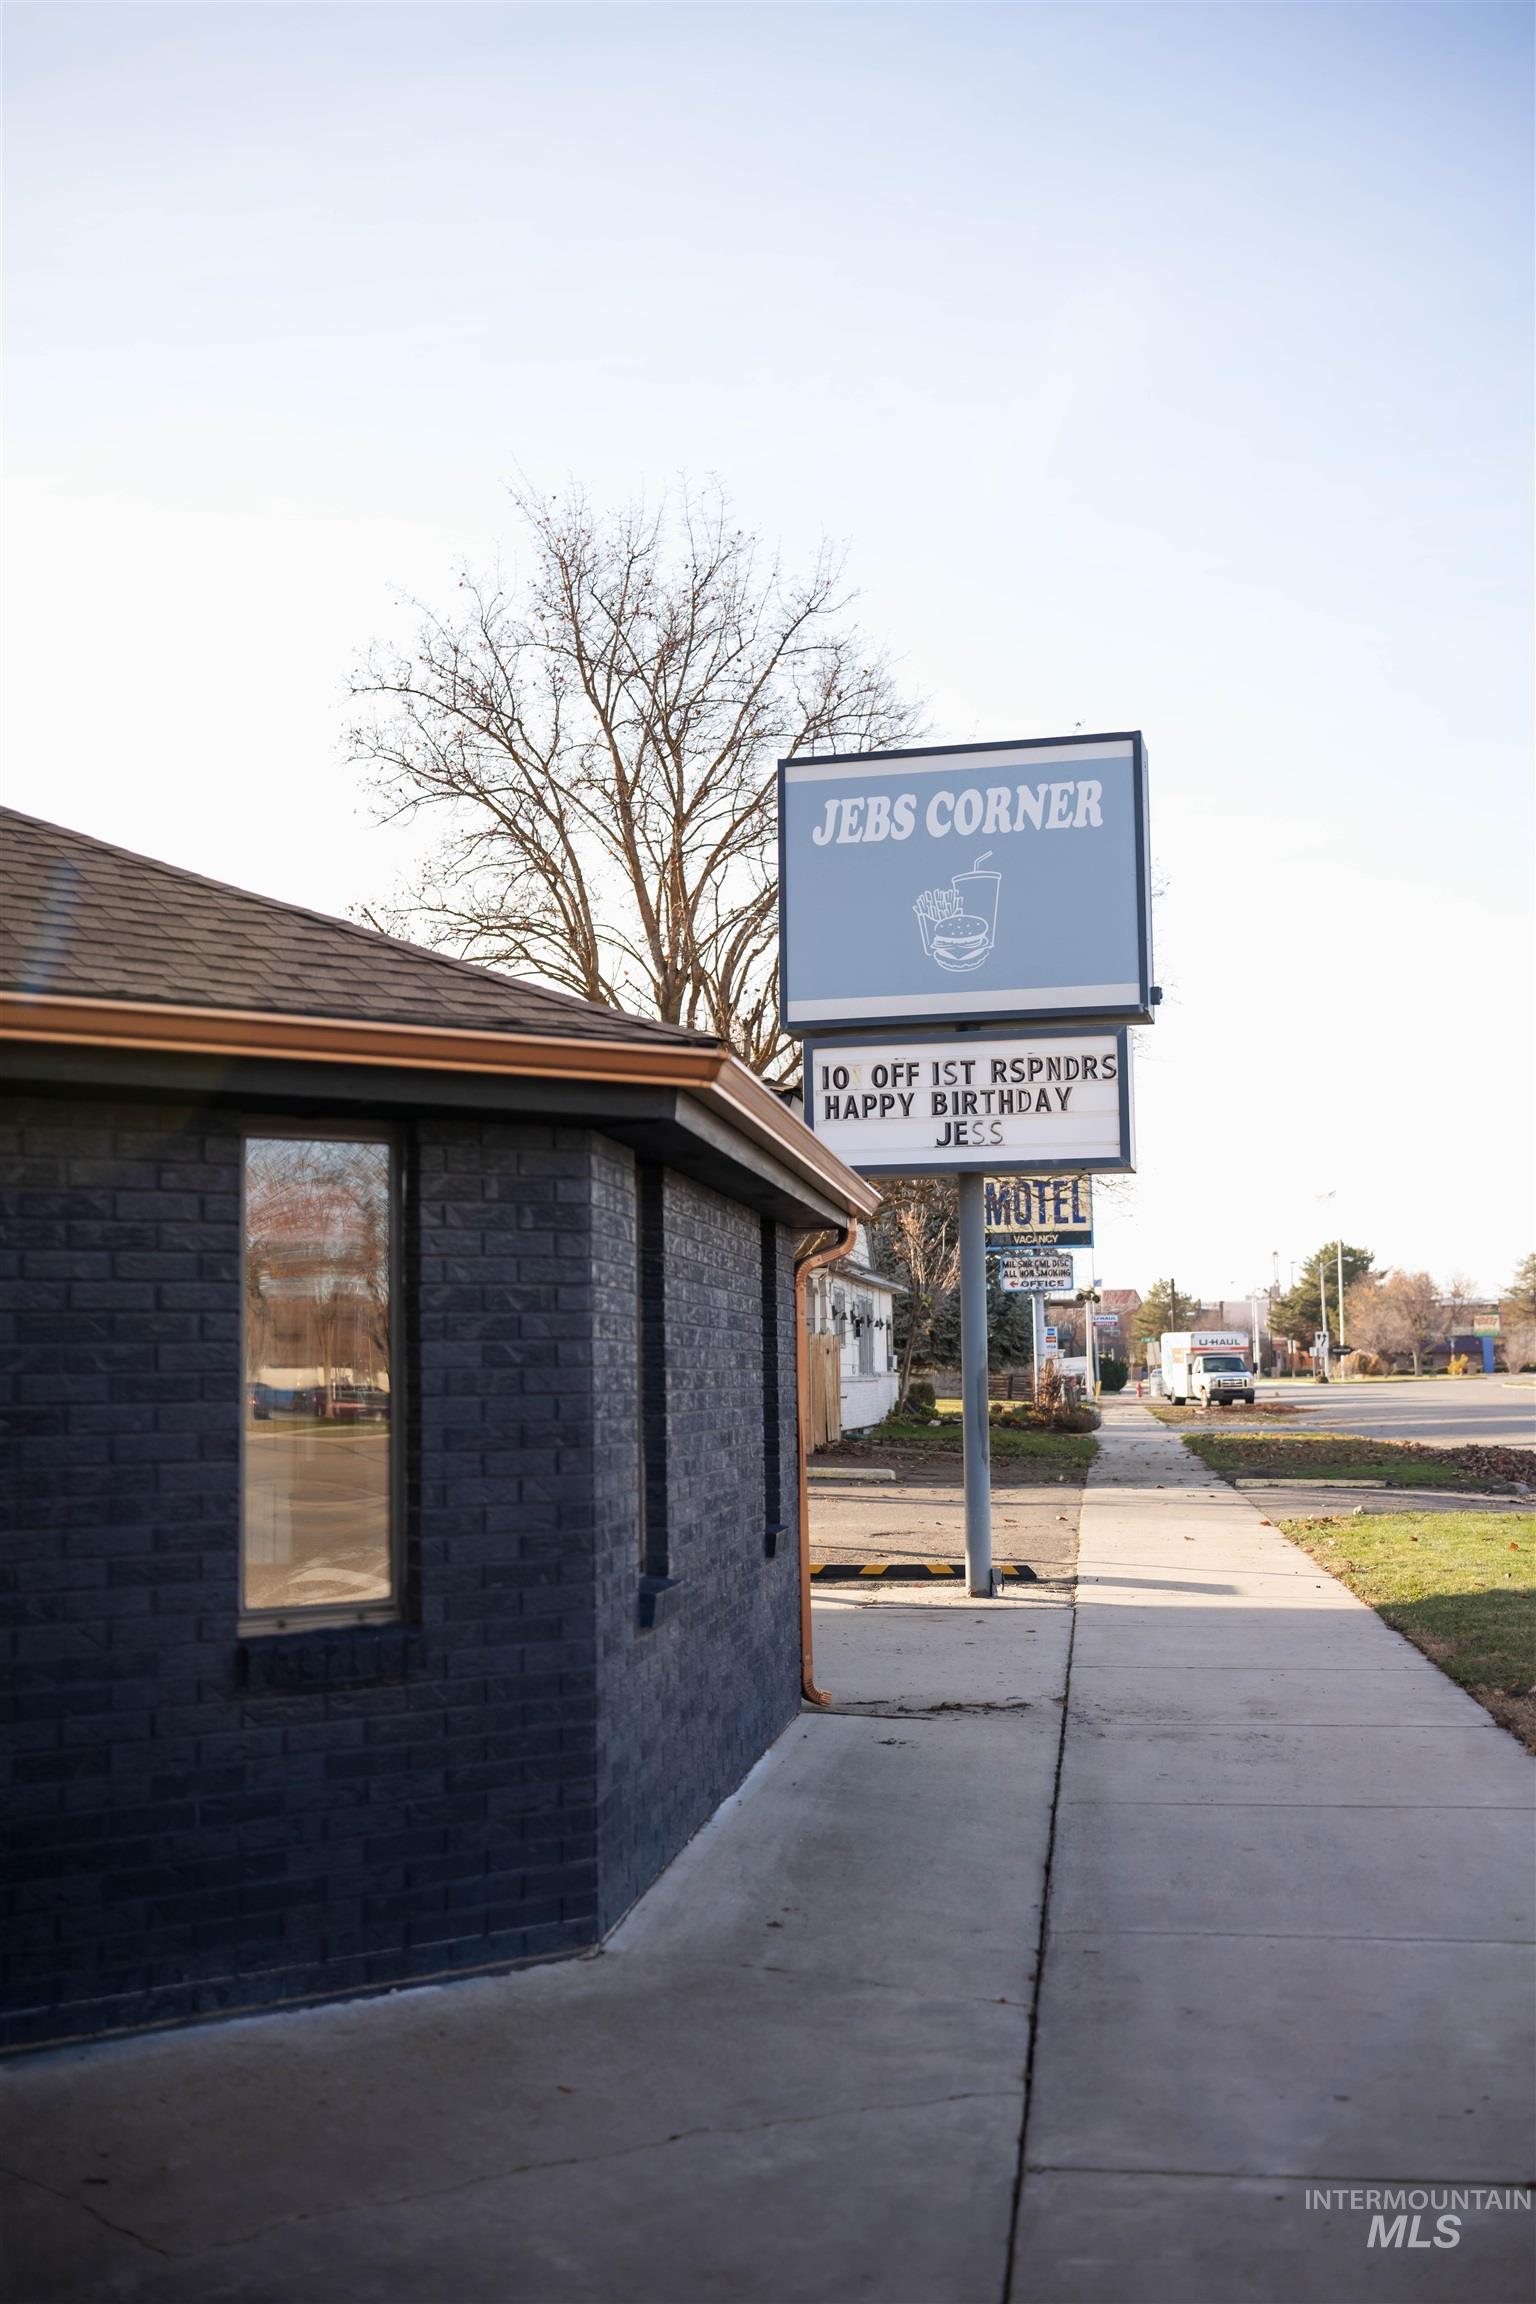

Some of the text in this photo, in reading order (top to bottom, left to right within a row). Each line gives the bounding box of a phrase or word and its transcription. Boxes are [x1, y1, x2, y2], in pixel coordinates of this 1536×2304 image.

[812, 780, 1103, 846] JEBS CORNER
[871, 1062, 920, 1088] OFF
[990, 1054, 1117, 1083] RSPNDRS
[825, 1086, 1073, 1120] HAPPY BIRTHDAY
[936, 1119, 1004, 1146] JESS
[984, 1179, 1087, 1226] MOTEL
[1013, 1233, 1059, 1245] VACANCY
[1003, 1270, 1017, 1278] ALL
[1036, 1268, 1071, 1278] SMOKING
[1020, 1280, 1065, 1288] OFFICE
[1198, 1338, 1241, 1346] U-HAUL
